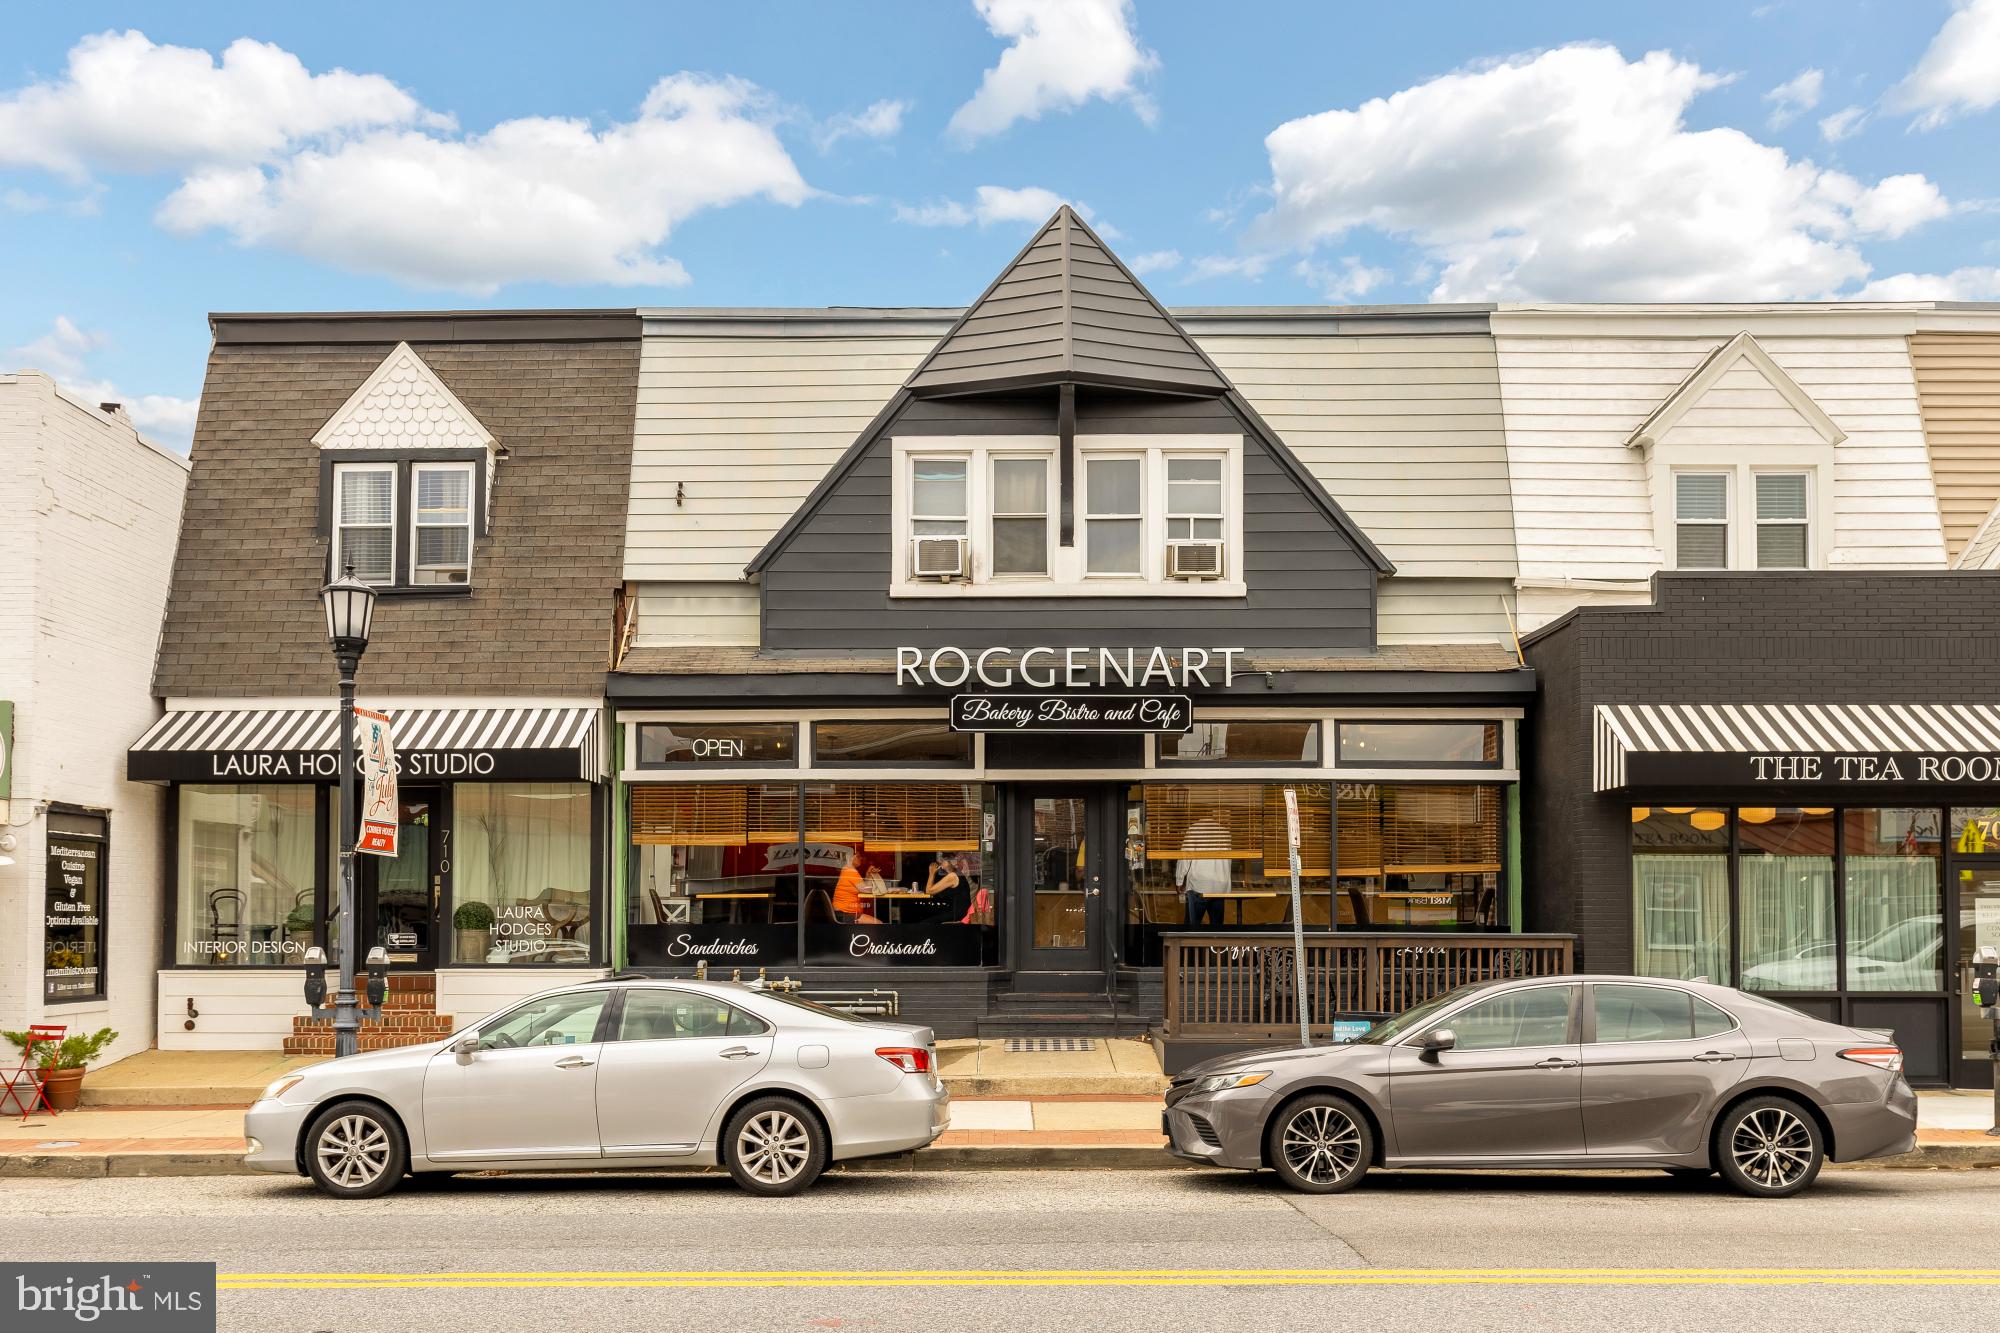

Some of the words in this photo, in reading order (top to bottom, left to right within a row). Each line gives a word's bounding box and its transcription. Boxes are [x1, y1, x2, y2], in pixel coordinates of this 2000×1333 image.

[897, 646, 1245, 688] ROGGENART
[961, 699, 1034, 728] Bakery
[1038, 699, 1100, 722] Bistro
[1104, 704, 1135, 722] and
[1139, 698, 1181, 729] Cafe
[692, 738, 743, 757] OPEN
[212, 753, 291, 776] LAURA
[409, 752, 495, 776] STUDIO
[1750, 756, 1823, 780] THE
[1834, 756, 1905, 781] TEA
[1917, 756, 2000, 782] ROO
[369, 768, 395, 817] July
[50, 845, 96, 859] Mediterranean
[440, 829, 450, 873] 710
[61, 860, 86, 872] Cuisine
[64, 874, 83, 886] Vegan
[69, 888, 77, 898] &
[54, 901, 76, 912] Gluten
[77, 902, 91, 912] Free
[496, 906, 544, 919] LAURA
[71, 915, 99, 926] Available
[489, 923, 552, 936] HODGES
[183, 940, 247, 954] INTERIOR
[251, 940, 306, 954] DESIGN
[495, 939, 547, 952] STUDIO
[667, 933, 759, 957] Sandwiches
[850, 933, 937, 957] Croissants
